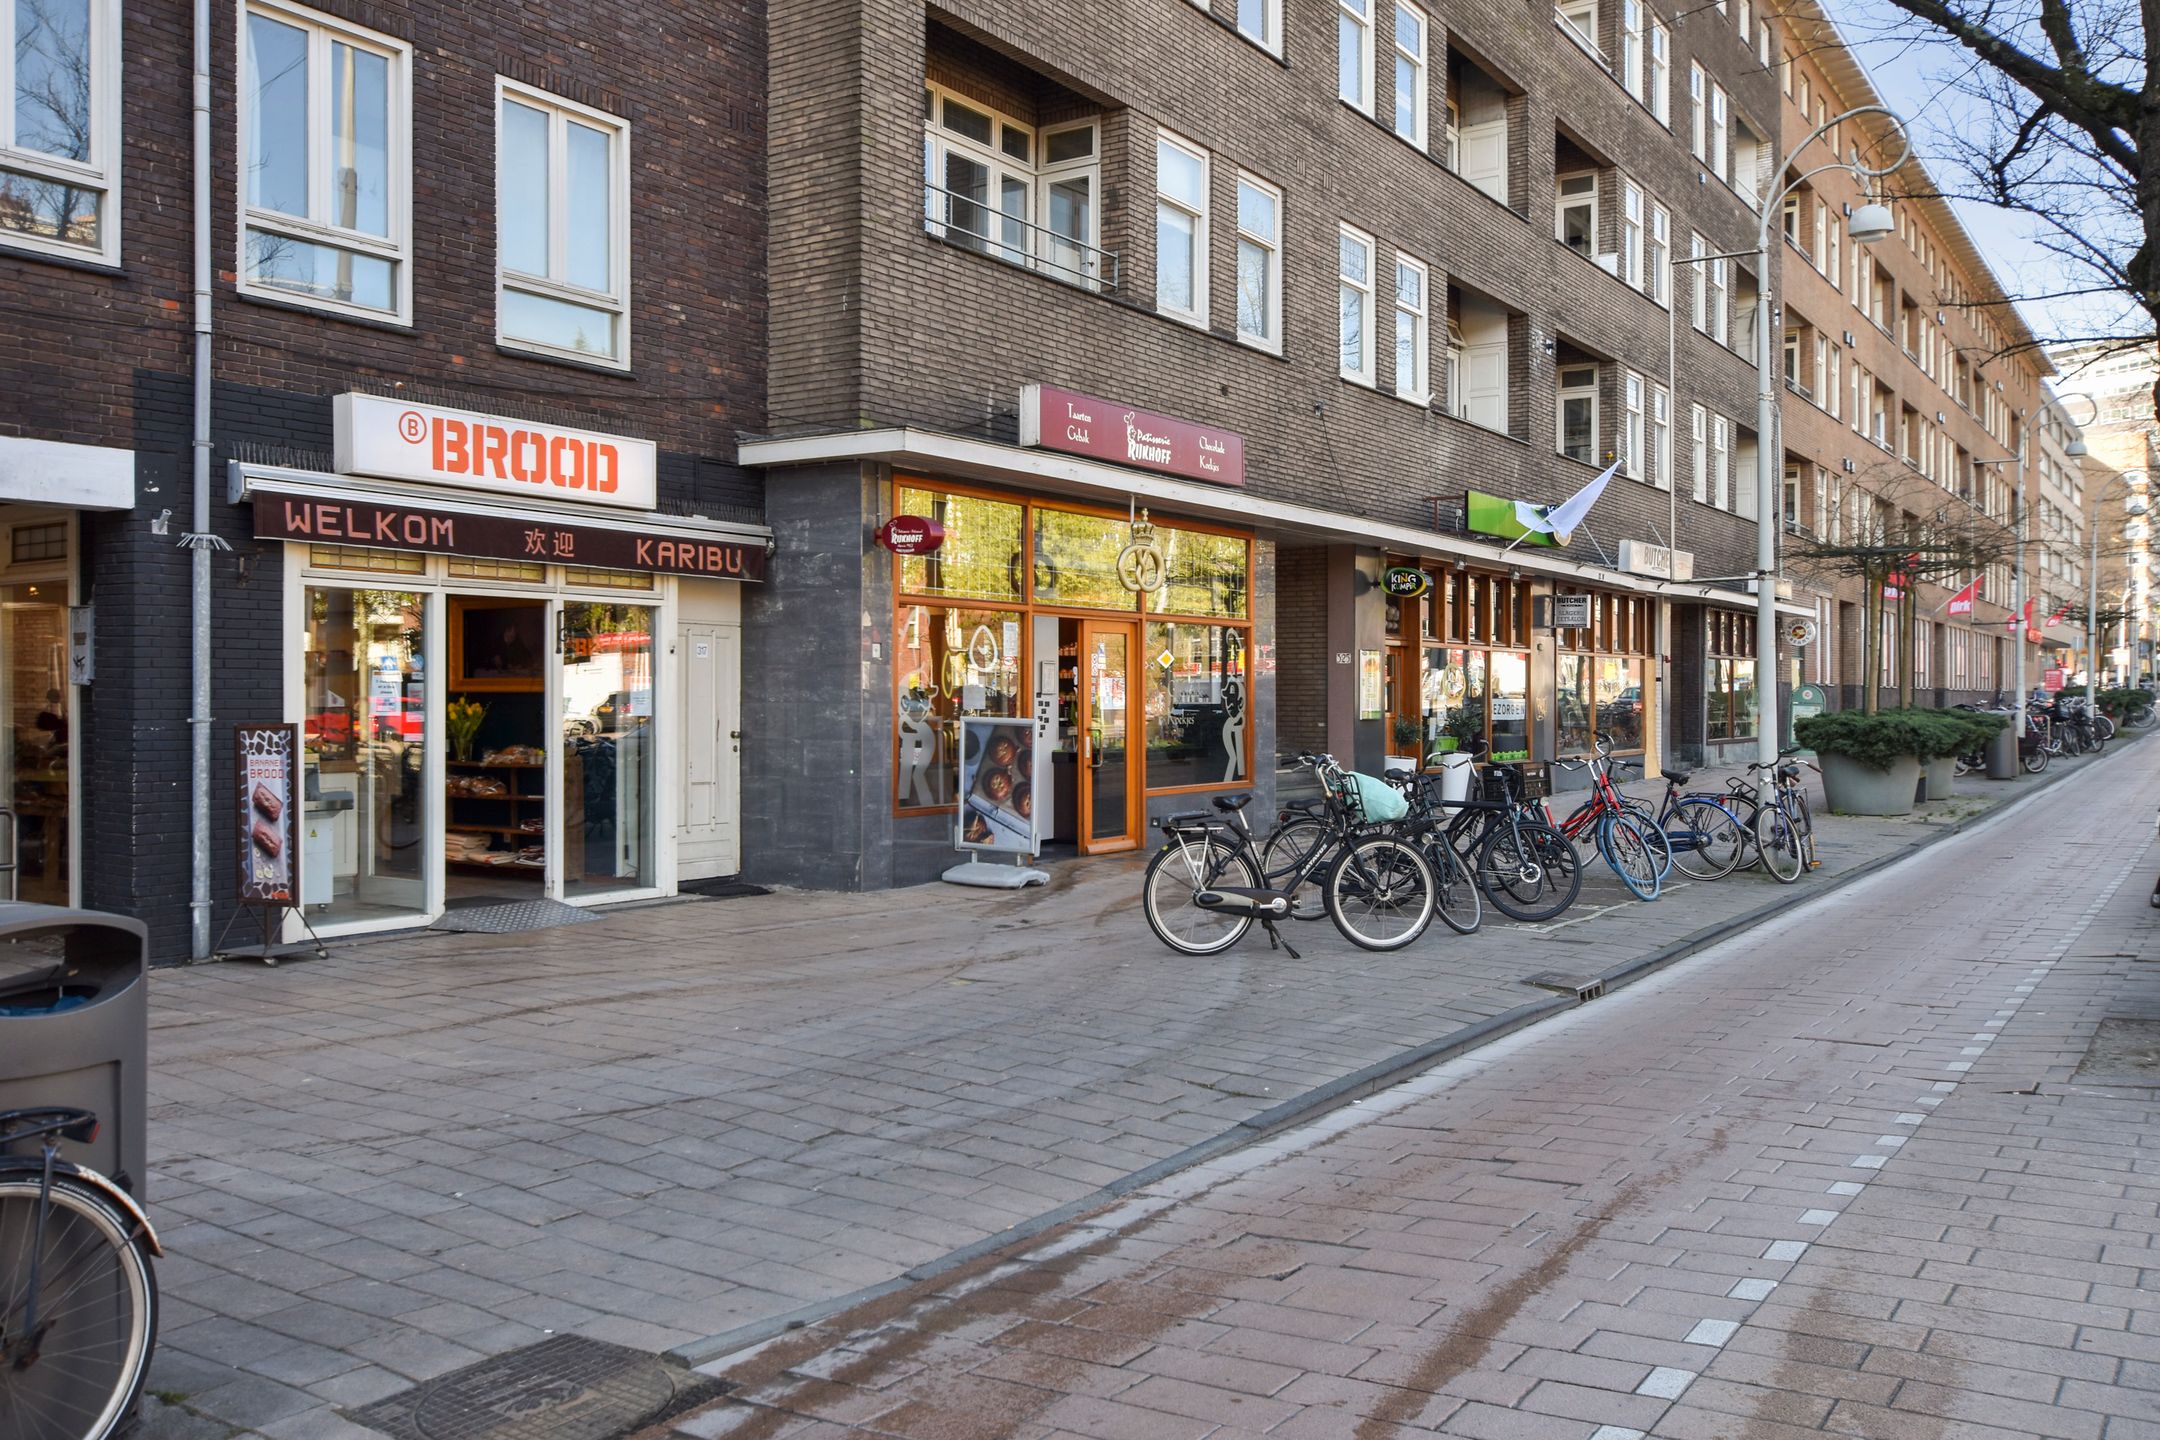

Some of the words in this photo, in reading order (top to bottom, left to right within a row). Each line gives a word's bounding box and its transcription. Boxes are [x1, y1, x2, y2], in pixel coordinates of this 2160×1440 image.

[1067, 403, 1092, 423] Taarten
[1067, 425, 1089, 444] Gebak
[1199, 436, 1225, 454] Chocolade
[432, 416, 618, 494] BROOD
[1127, 440, 1172, 465] RIJKHOFF
[1199, 455, 1220, 472] Koekjes
[285, 501, 454, 547] WELKOM
[524, 528, 575, 558] 欢迎
[636, 538, 742, 574] KARIBU
[1644, 545, 1671, 569] BUTCHE
[1391, 572, 1417, 584] KING
[1493, 703, 1525, 715] EZORGEN
[250, 768, 286, 779] BROOD
[1300, 843, 1328, 876] BATAVUS
